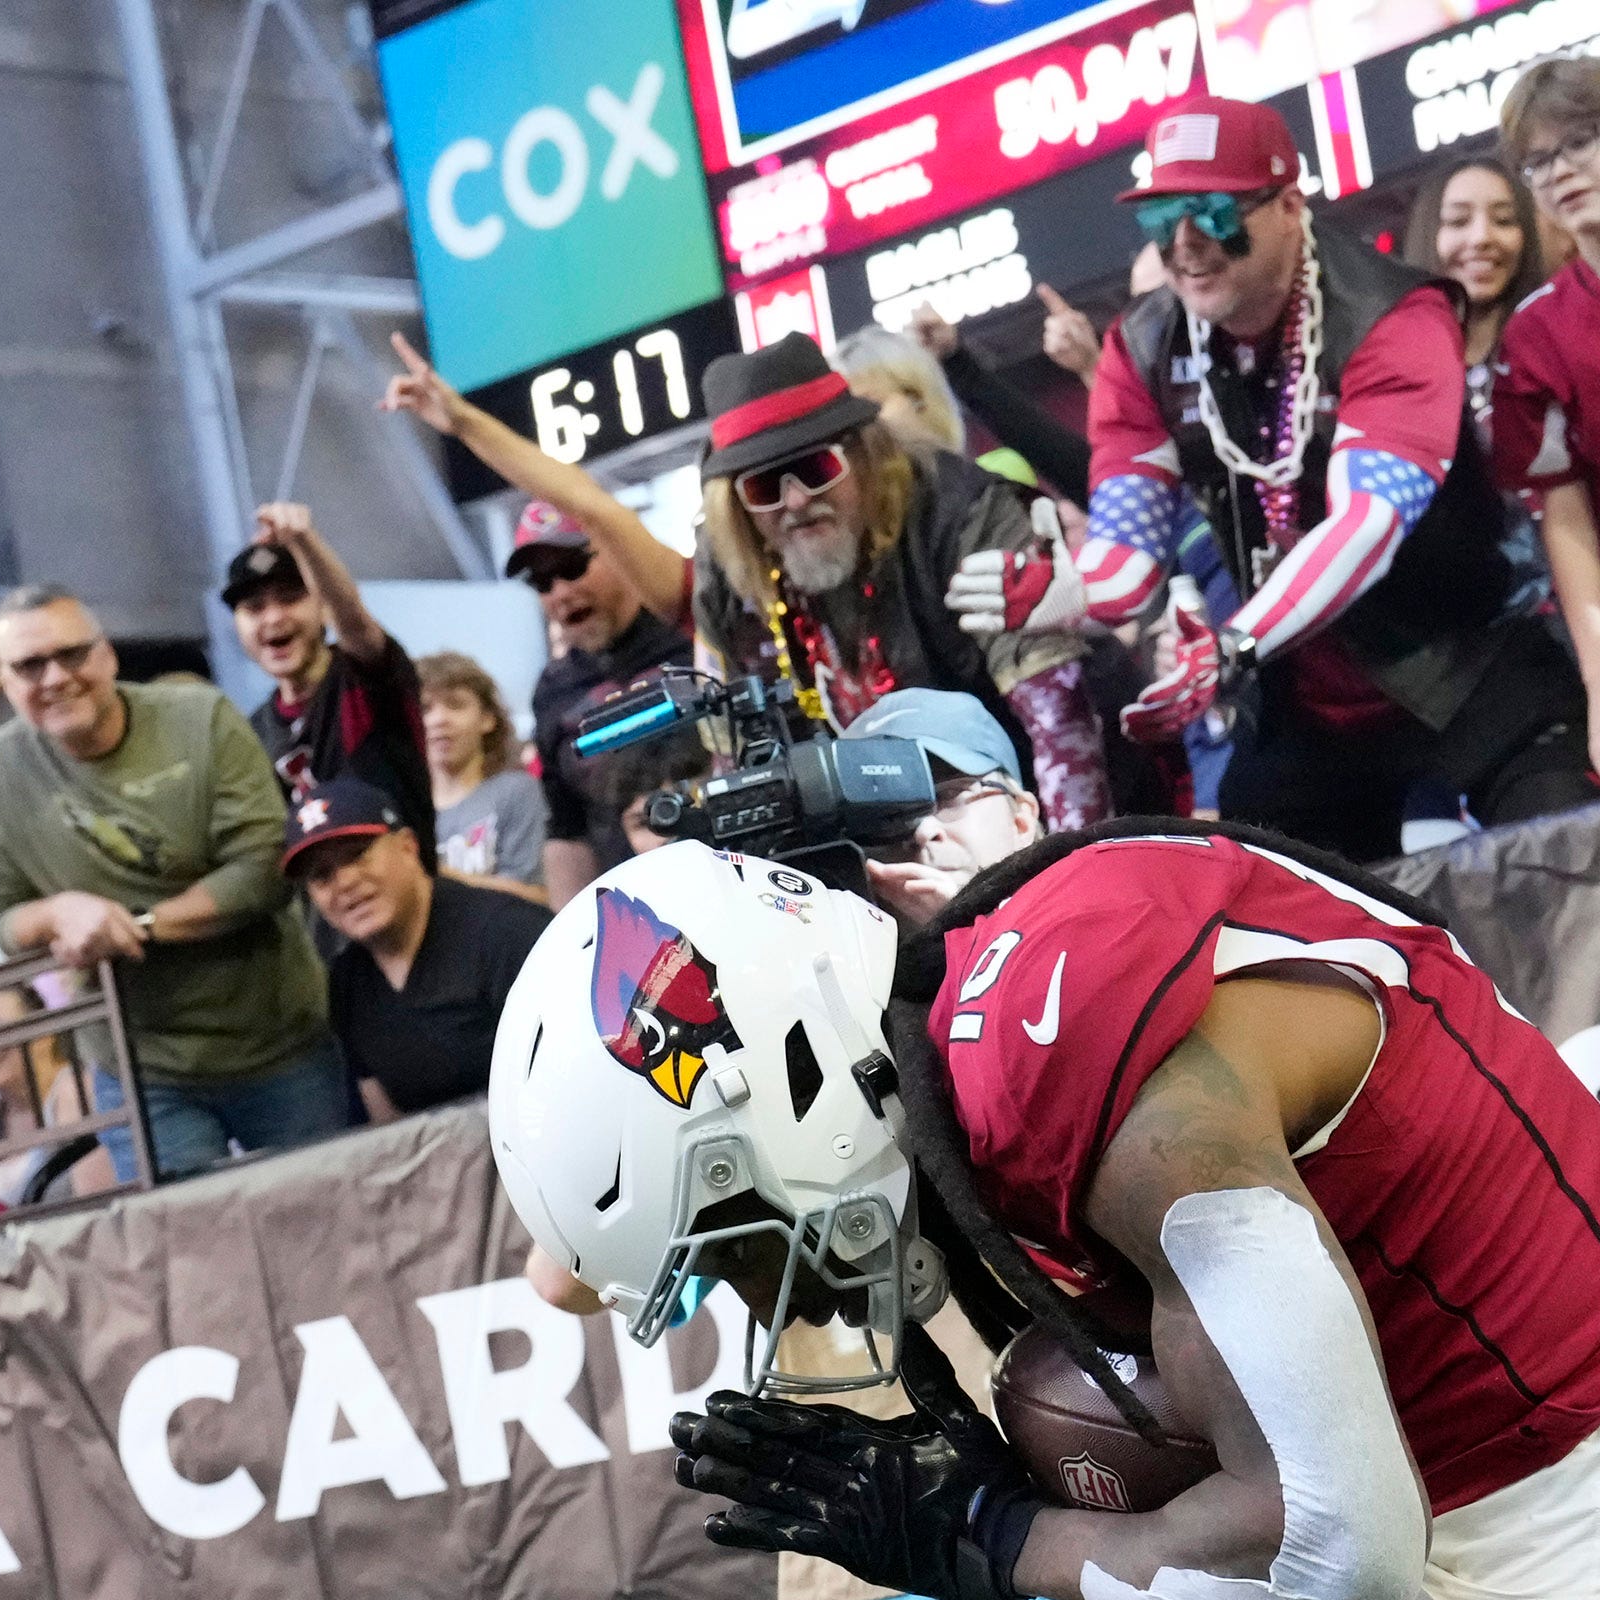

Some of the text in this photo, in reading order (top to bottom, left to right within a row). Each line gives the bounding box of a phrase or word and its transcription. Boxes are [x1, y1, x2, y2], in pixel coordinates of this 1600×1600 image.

[427, 62, 679, 260] COX
[531, 329, 690, 464] 6:17
[776, 872, 804, 893] 40
[1066, 1466, 1126, 1510] NFL
